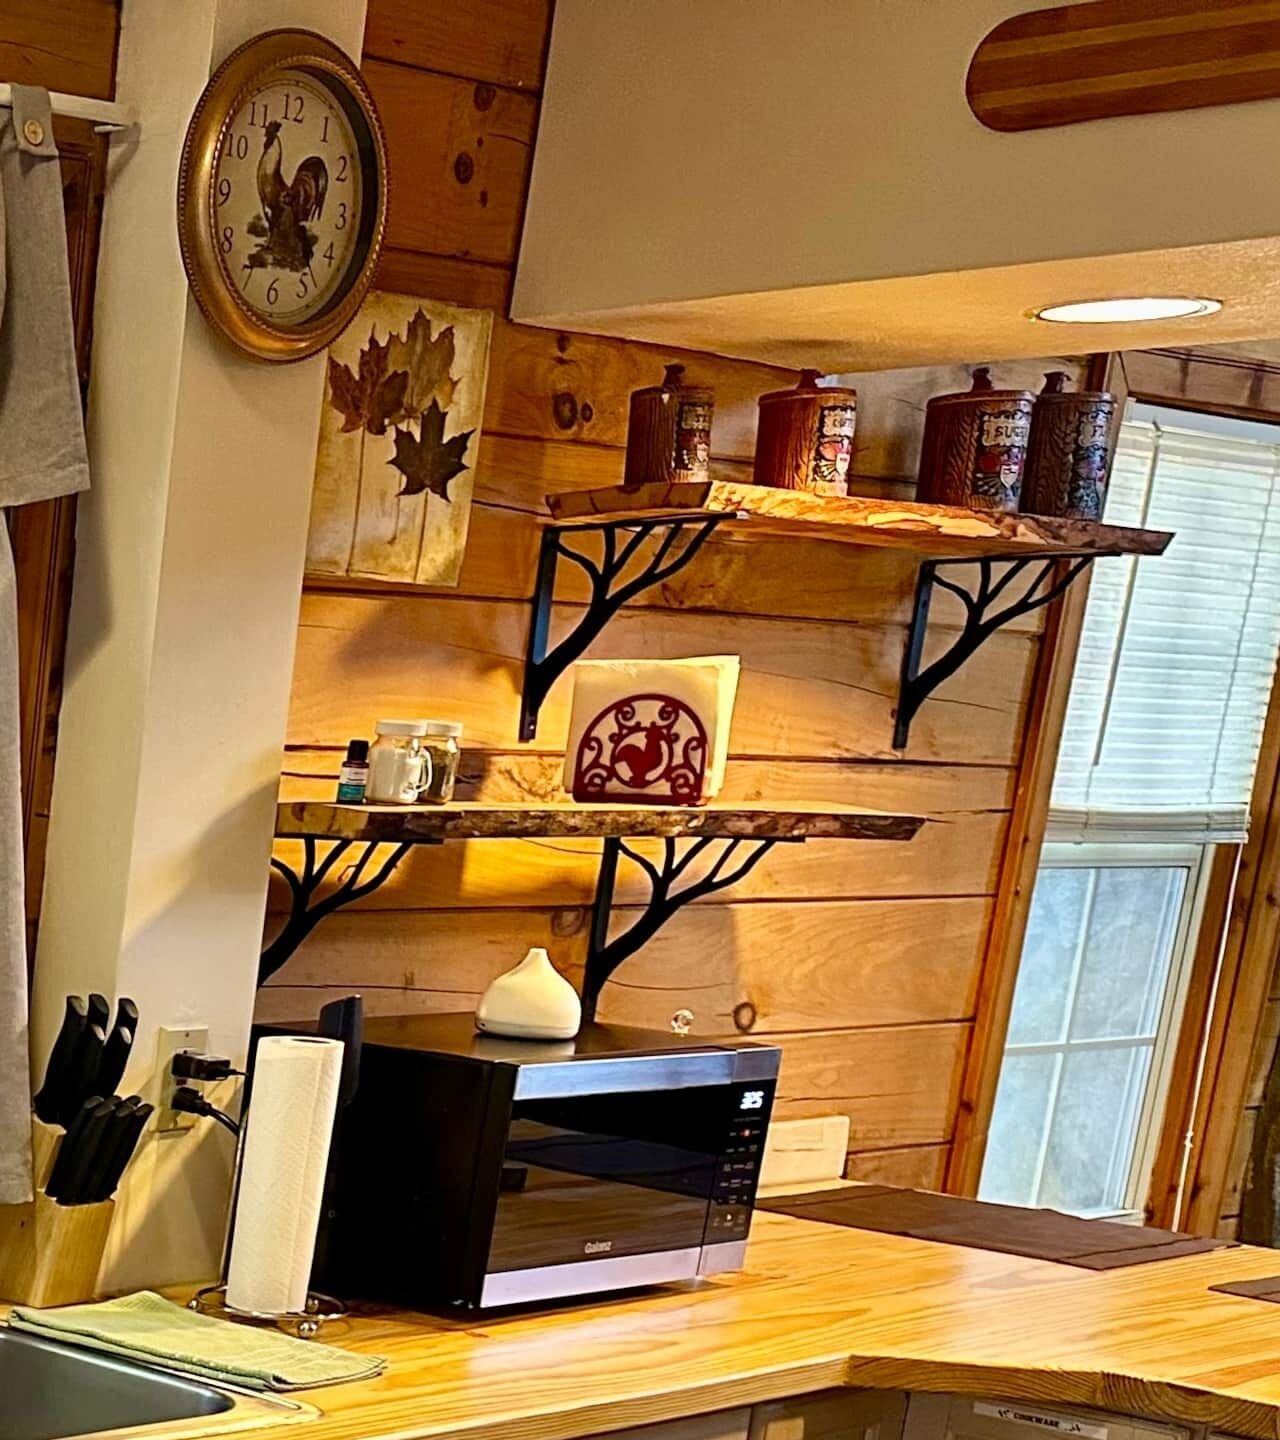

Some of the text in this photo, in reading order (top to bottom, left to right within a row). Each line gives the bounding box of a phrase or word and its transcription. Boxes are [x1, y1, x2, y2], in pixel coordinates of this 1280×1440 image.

[247, 101, 268, 128] 11
[282, 93, 304, 123] 12
[320, 116, 329, 143] 1
[226, 133, 248, 160] 10
[335, 155, 347, 182] 2
[218, 178, 231, 208] 9
[335, 203, 346, 230] 3
[220, 226, 234, 254] 8
[322, 241, 335, 268] 4
[266, 278, 279, 305] 6
[296, 272, 308, 299] 5
